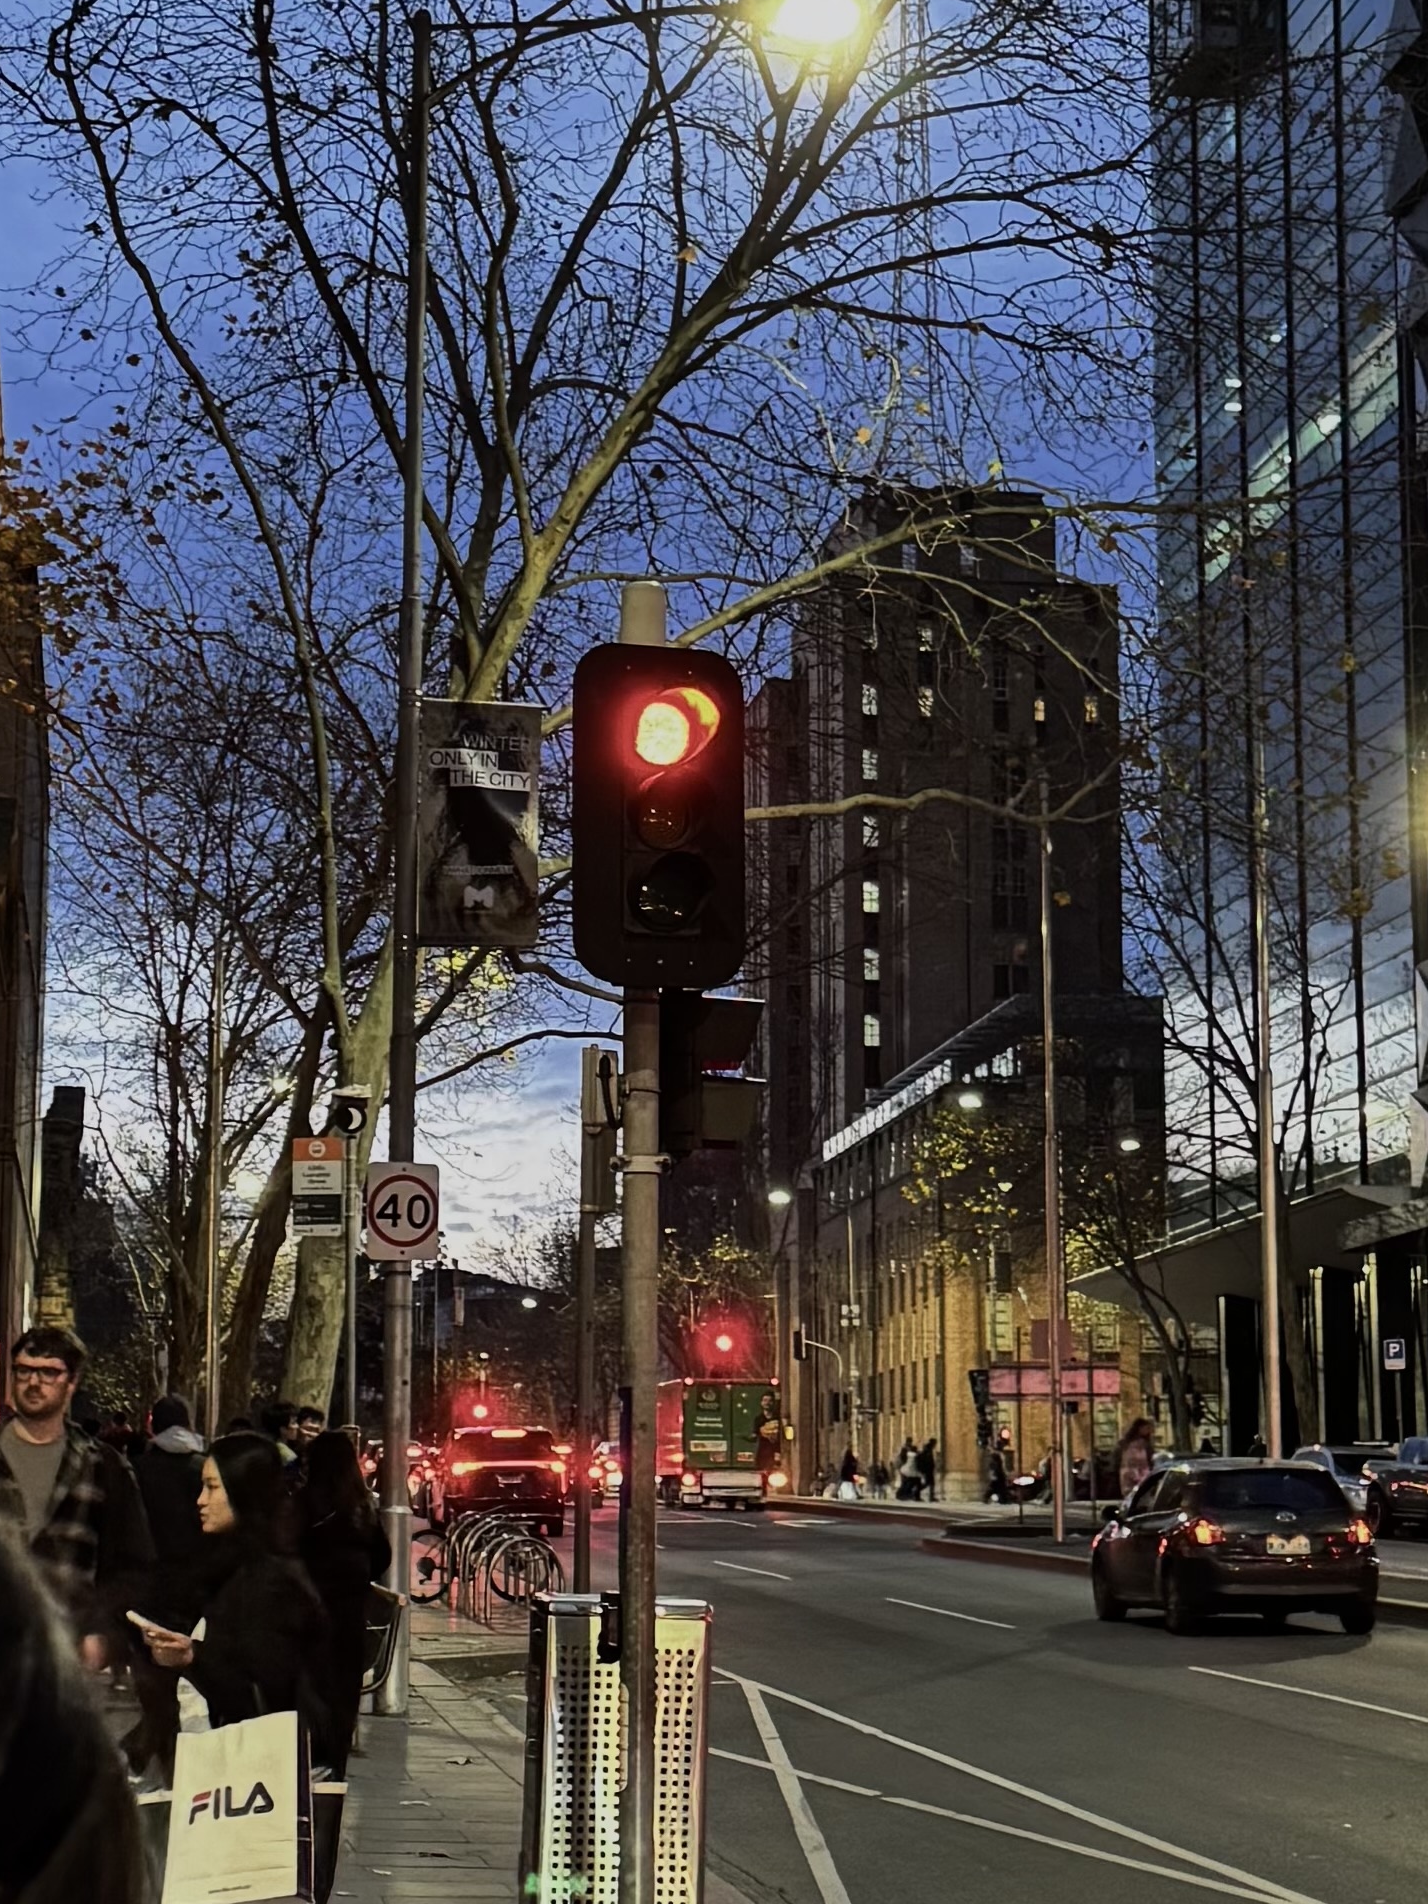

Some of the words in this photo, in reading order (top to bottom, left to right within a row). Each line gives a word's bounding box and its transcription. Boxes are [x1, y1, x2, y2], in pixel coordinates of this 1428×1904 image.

[462, 733, 530, 752] WINTER
[429, 750, 478, 766] ONLY
[480, 752, 498, 768] IN
[452, 769, 486, 785] THE
[489, 772, 531, 788] CITY
[375, 1193, 430, 1229] 40
[1388, 1342, 1400, 1358] P
[188, 1781, 275, 1825] FILA
